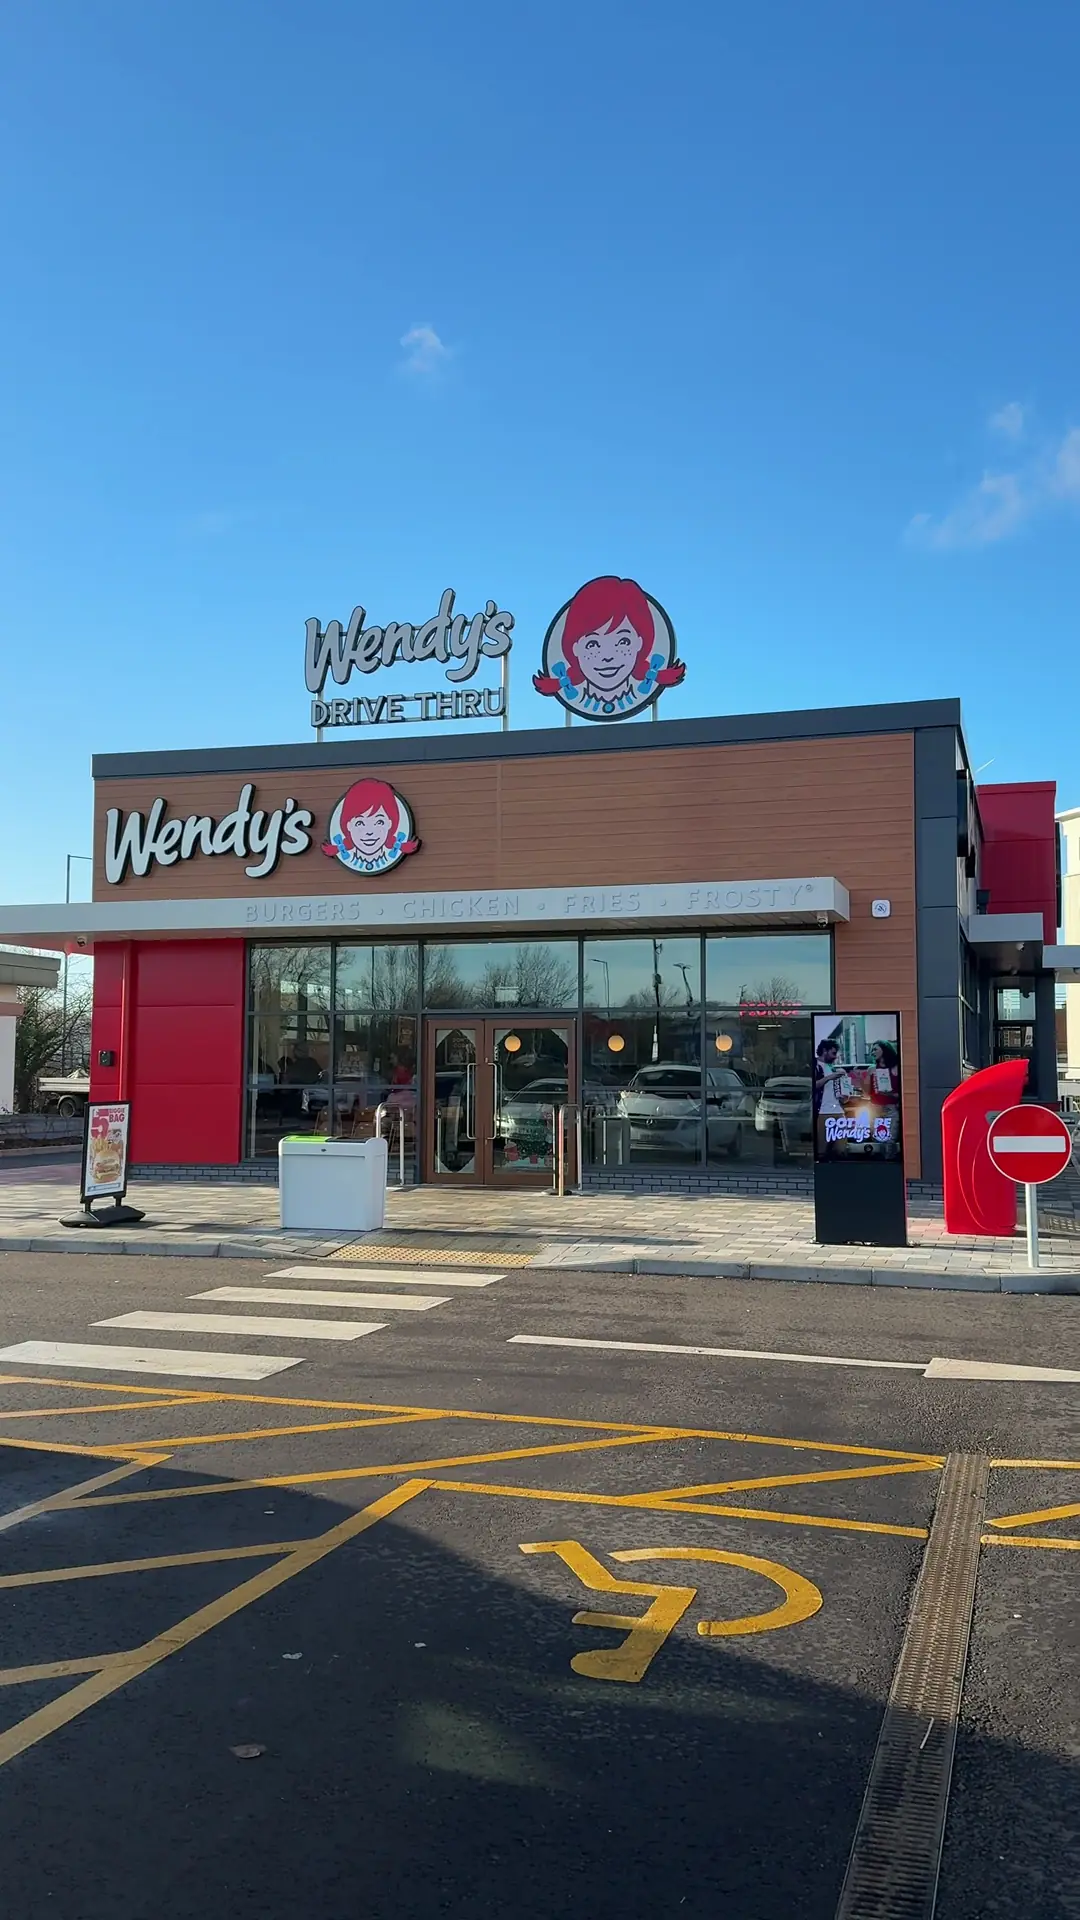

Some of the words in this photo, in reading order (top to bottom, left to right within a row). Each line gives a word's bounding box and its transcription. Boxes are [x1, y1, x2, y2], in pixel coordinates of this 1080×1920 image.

[305, 588, 515, 694] Wendy's
[311, 694, 404, 727] DRIVE
[414, 687, 506, 720] THRU
[105, 783, 315, 885] Wendy's
[245, 901, 361, 923] BURGERS
[402, 895, 520, 919] CHICKEN
[563, 892, 641, 914] FRIES
[109, 1113, 125, 1123] BAG
[825, 1126, 870, 1143] Wendy's
